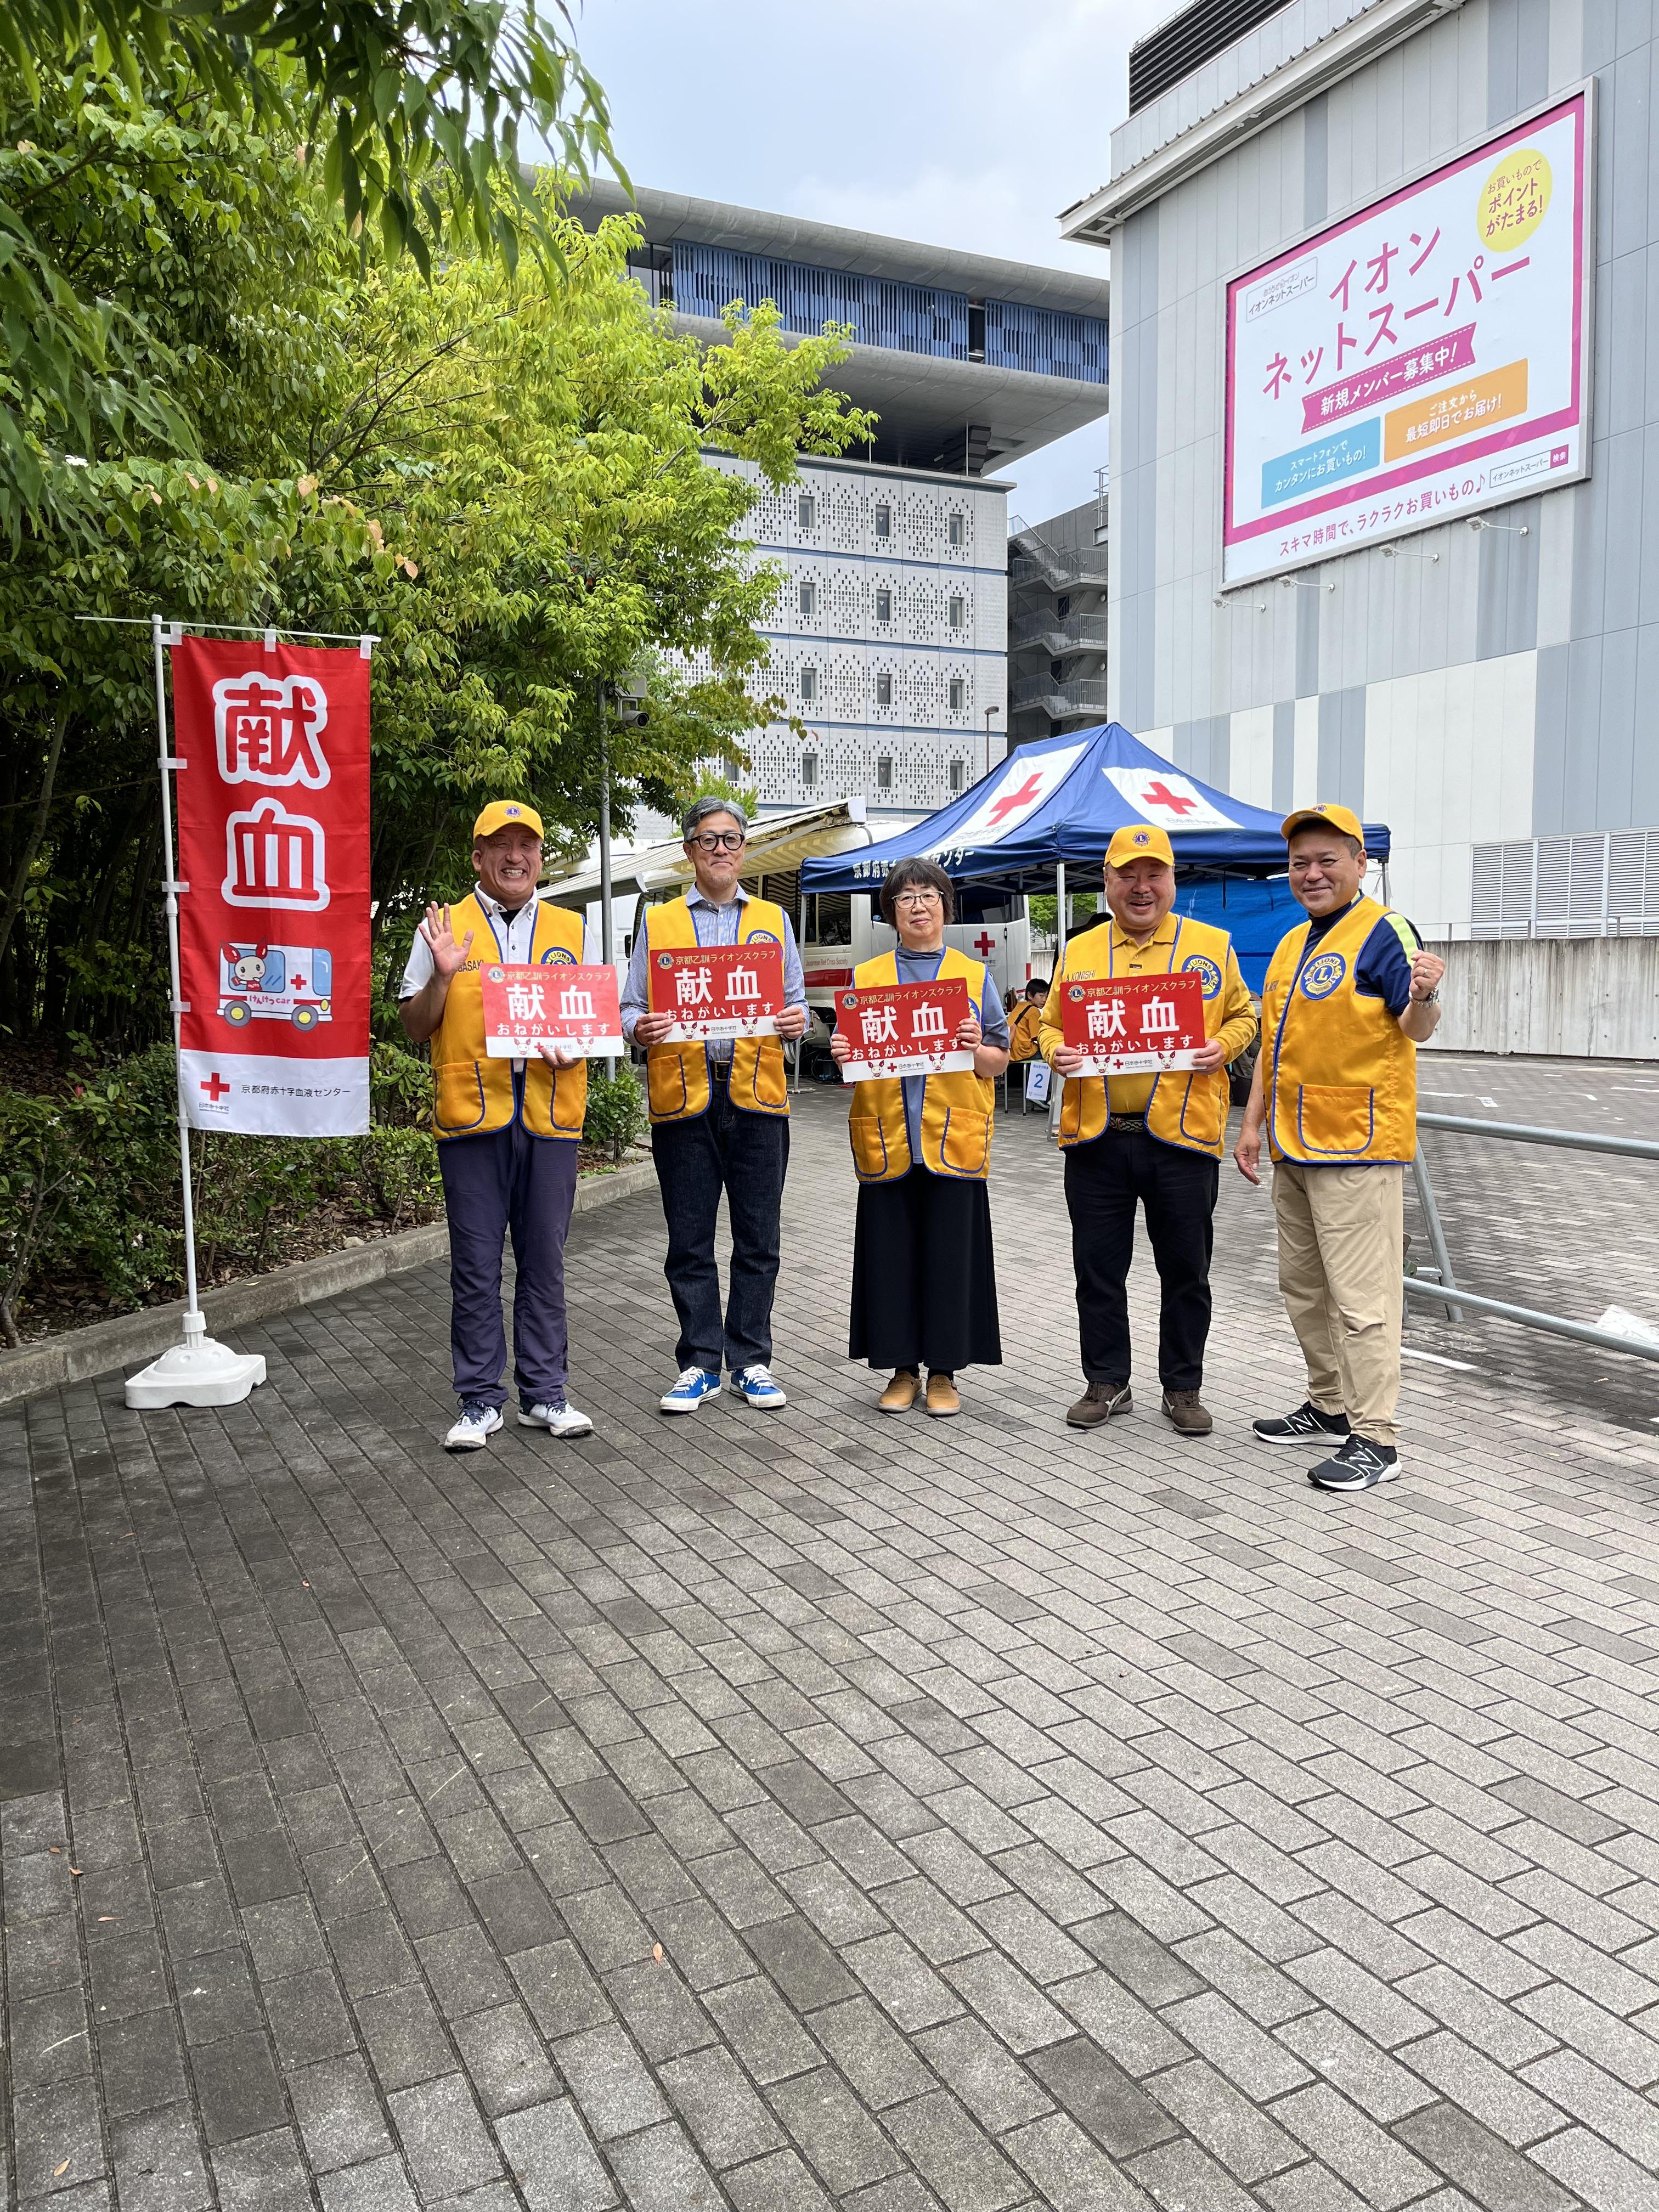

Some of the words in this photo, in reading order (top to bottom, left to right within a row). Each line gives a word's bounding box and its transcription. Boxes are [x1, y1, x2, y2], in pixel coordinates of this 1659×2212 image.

[1487, 159, 1542, 194] お買いもので
[1488, 177, 1538, 213] ポイント
[1486, 194, 1543, 238] がたまる!
[1329, 225, 1441, 312] イオン
[1249, 276, 1314, 315] イオンネットスーパー
[1262, 255, 1531, 400] ネットスーパー
[1321, 341, 1457, 416] 新規メンバー募集中!
[1429, 390, 1477, 417] ご注文から
[1405, 394, 1502, 443] 最短即日でお届け!
[1275, 445, 1367, 493] カンタンにお買いもの!
[1291, 440, 1348, 471] スマートフォンで
[1492, 458, 1549, 482] イオンネットスーパー
[212, 672, 331, 911] 献血
[550, 952, 570, 962] LIONS
[675, 950, 777, 965] 京都乙訓ライオンズクラブ
[1192, 960, 1212, 969] LIONS
[1317, 957, 1339, 966] LIONS
[507, 971, 611, 981] 京都乙訓ライオンズクラブ
[674, 964, 762, 1006] 献血
[1086, 980, 1196, 997] 京都乙訓ライオンズクラブ
[249, 995, 274, 1005] けんけつ
[505, 983, 597, 1021] 献血
[859, 985, 962, 1005] 京都乙訓ライオンズクラブ
[665, 1002, 774, 1021] おねがいします
[859, 1001, 949, 1045] 献血
[1085, 996, 1180, 1039] 献血
[496, 1022, 611, 1036] おねがいします
[852, 1037, 961, 1060] おねがいします
[1076, 1034, 1194, 1055] おねがいします
[241, 1085, 351, 1098] 京都府赤十字血液センター
[1034, 1073, 1043, 1088] 2
